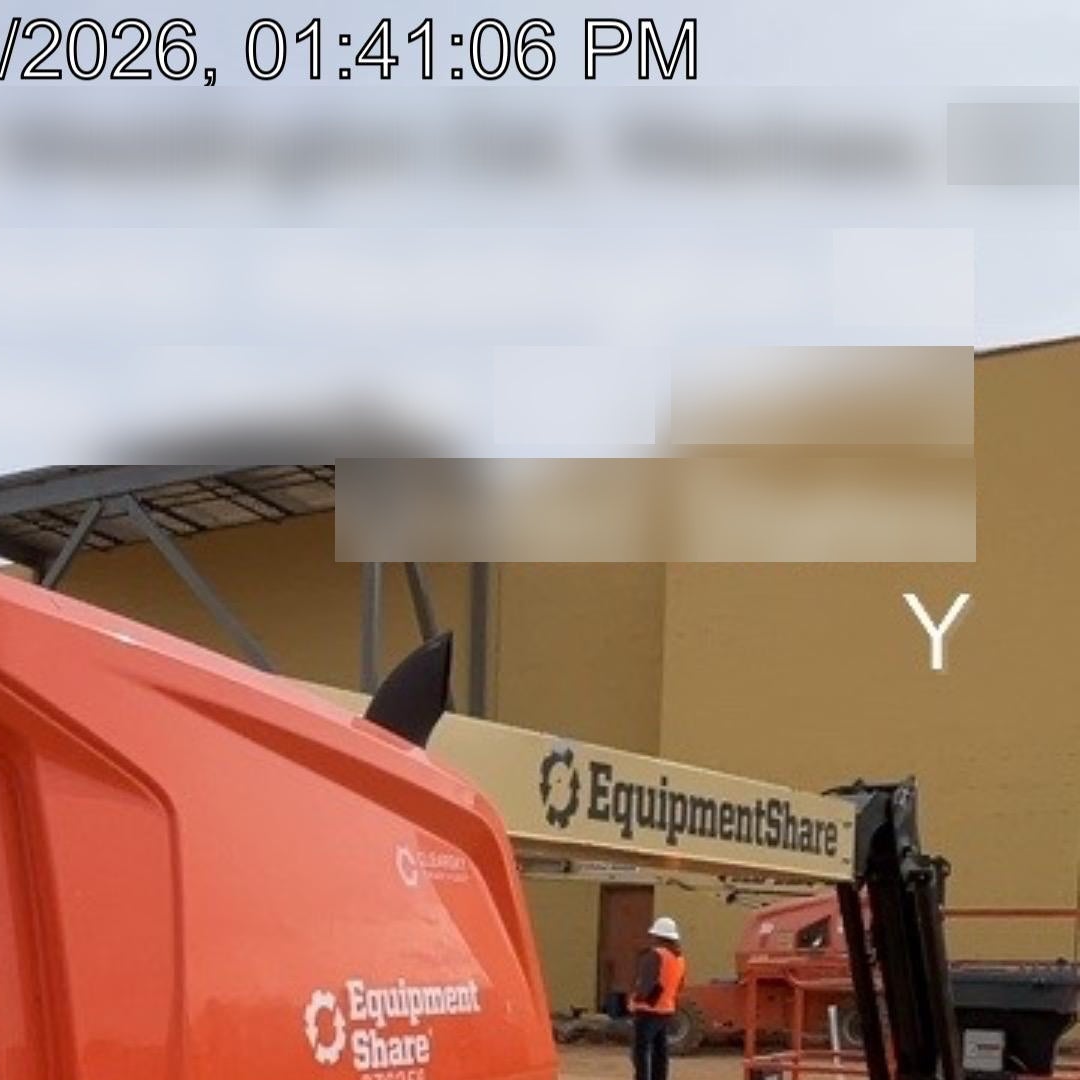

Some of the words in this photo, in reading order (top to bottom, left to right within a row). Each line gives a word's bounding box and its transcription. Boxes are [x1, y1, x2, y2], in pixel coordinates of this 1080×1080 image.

[587, 759, 838, 856] EquipmentShare
[345, 978, 481, 1028] Equipment
[351, 1028, 430, 1071] Share
